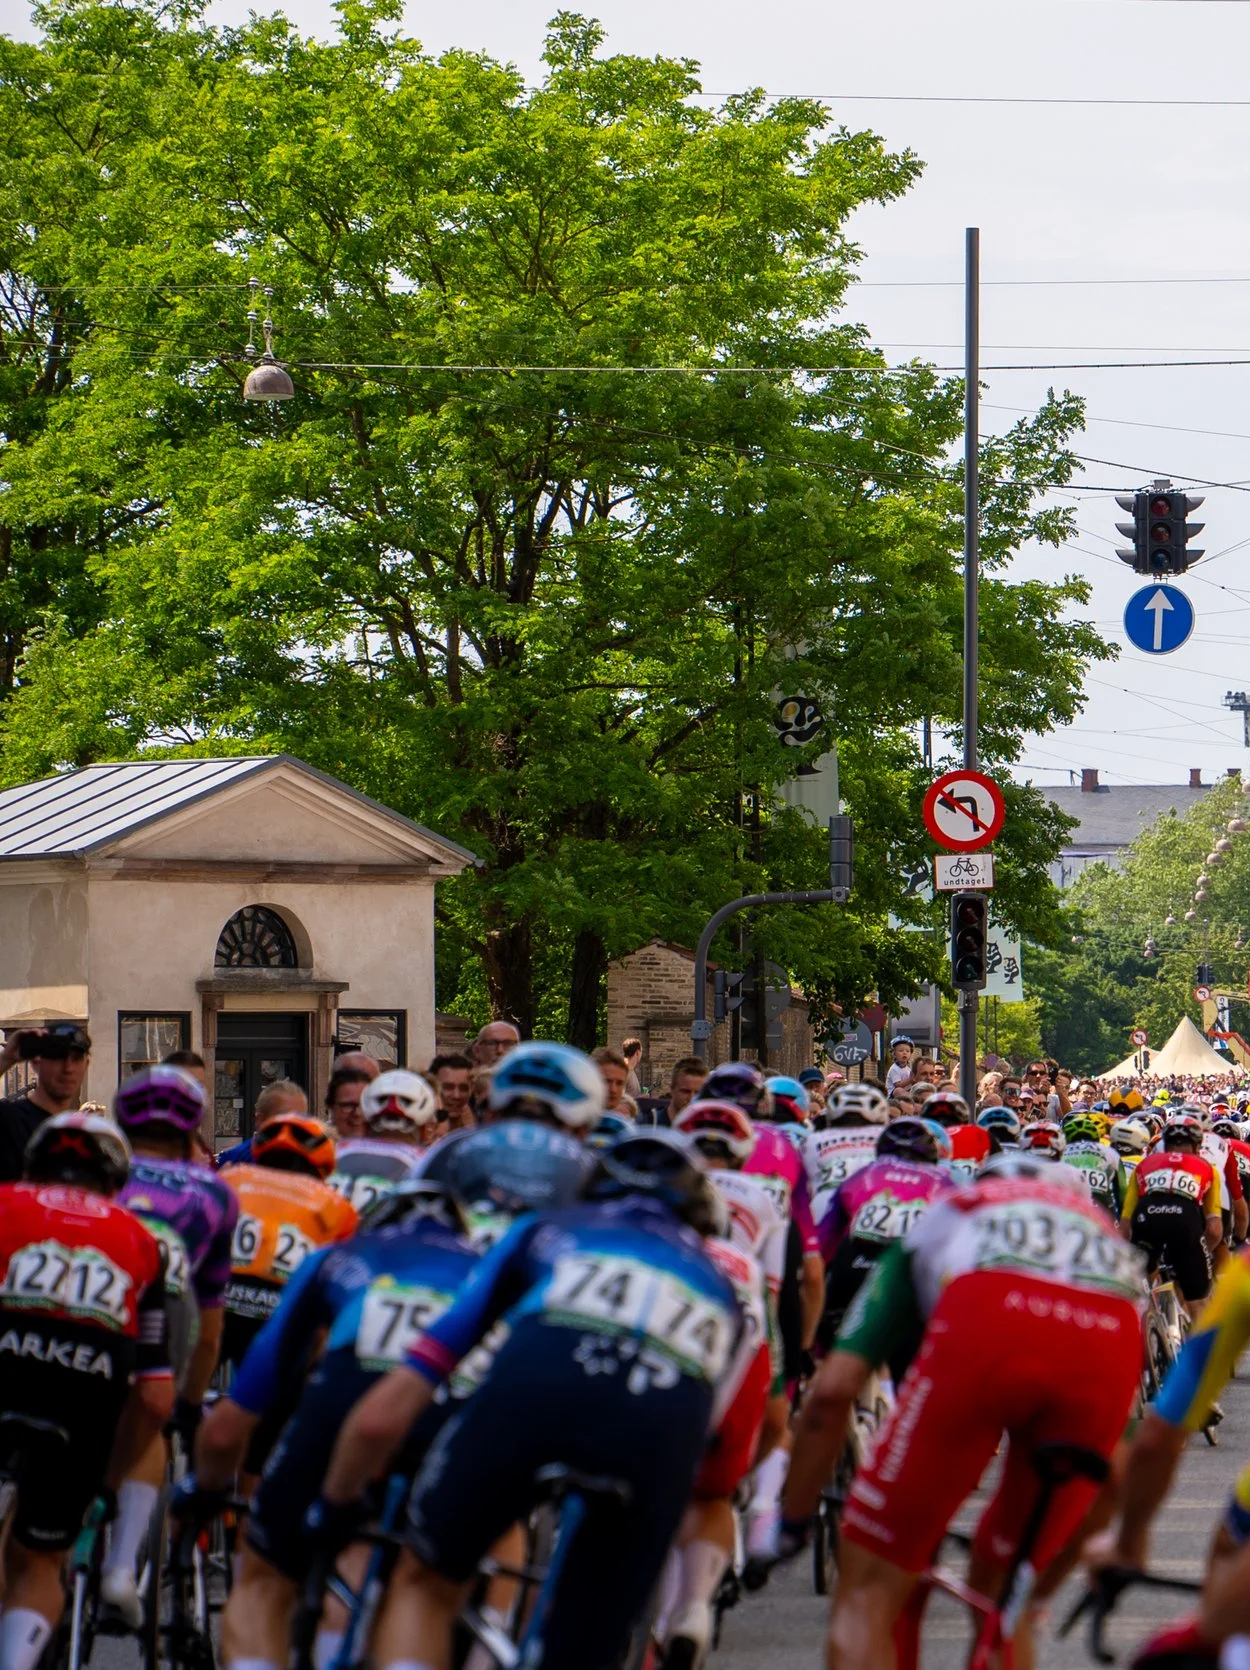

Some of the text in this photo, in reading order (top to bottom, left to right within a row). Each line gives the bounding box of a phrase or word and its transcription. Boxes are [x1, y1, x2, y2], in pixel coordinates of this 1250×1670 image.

[1177, 1175, 1196, 1194] 66
[1147, 1204, 1183, 1215] Cofidis
[7, 1252, 69, 1293] 127
[566, 1262, 632, 1314] 74
[0, 1328, 114, 1380] ARKEA
